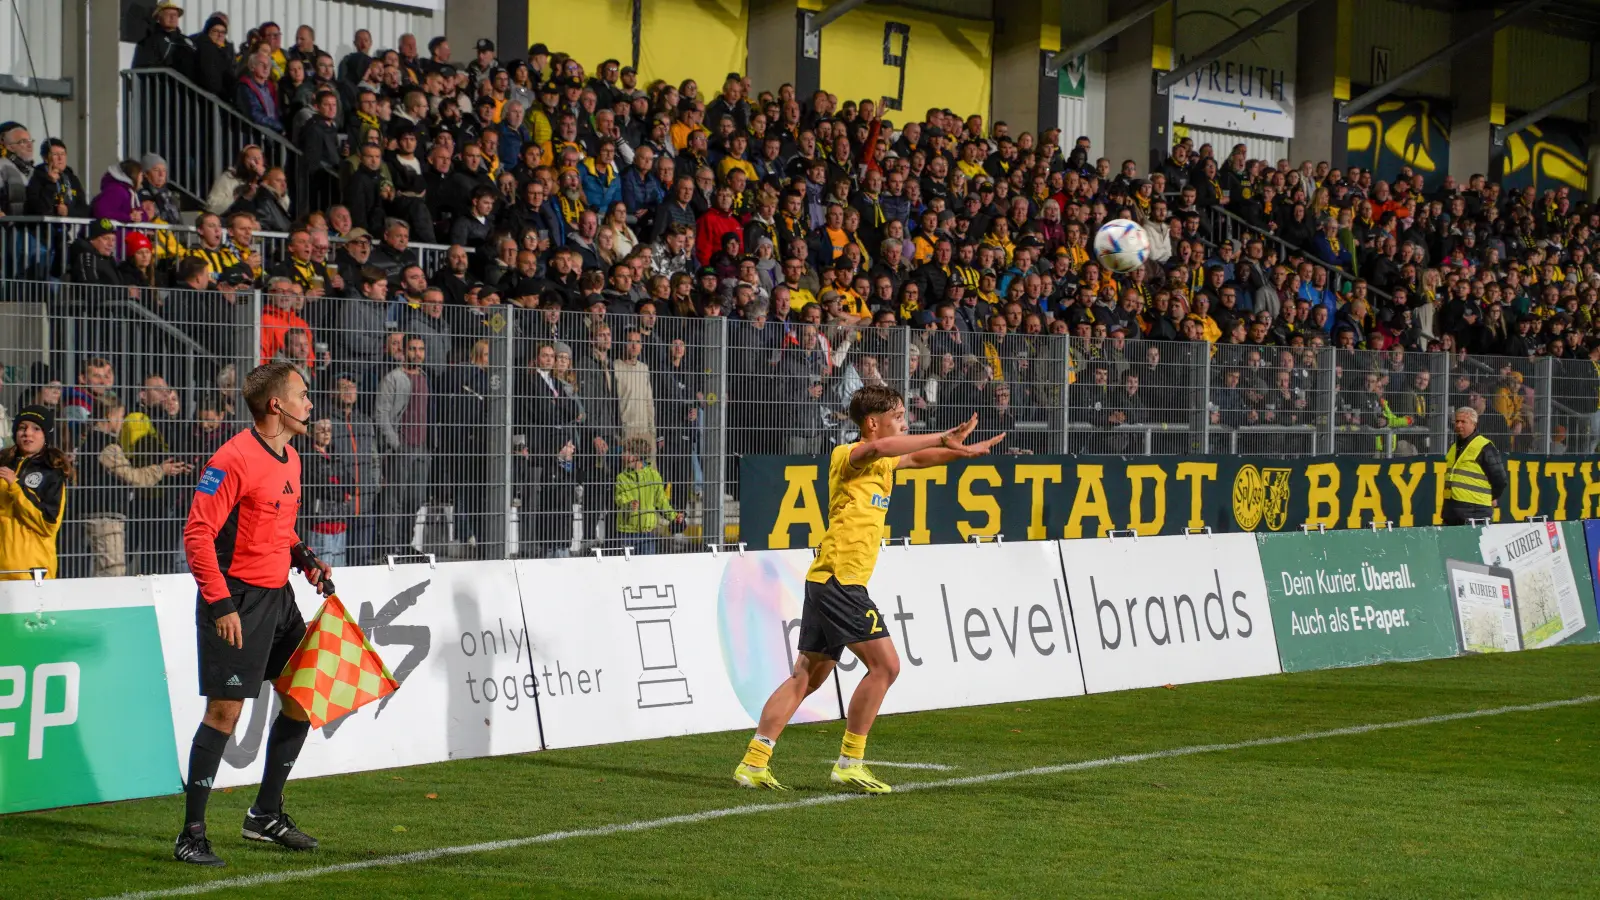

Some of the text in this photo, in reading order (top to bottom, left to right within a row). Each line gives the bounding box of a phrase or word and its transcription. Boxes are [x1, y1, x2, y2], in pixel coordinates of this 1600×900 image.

[881, 22, 911, 112] 9
[768, 461, 1218, 549] ATSTADT
[1305, 460, 1600, 531] BAYUTH
[1505, 529, 1544, 562] KURIER
[1281, 562, 1416, 596] Dein Kurier. Überall.
[1469, 582, 1499, 599] KURIER
[865, 609, 883, 635] 2
[940, 578, 1072, 663] level
[1089, 568, 1253, 650] brands
[1291, 605, 1410, 635] Auch als E-Paper.
[460, 617, 524, 664] only
[465, 659, 603, 711] together
